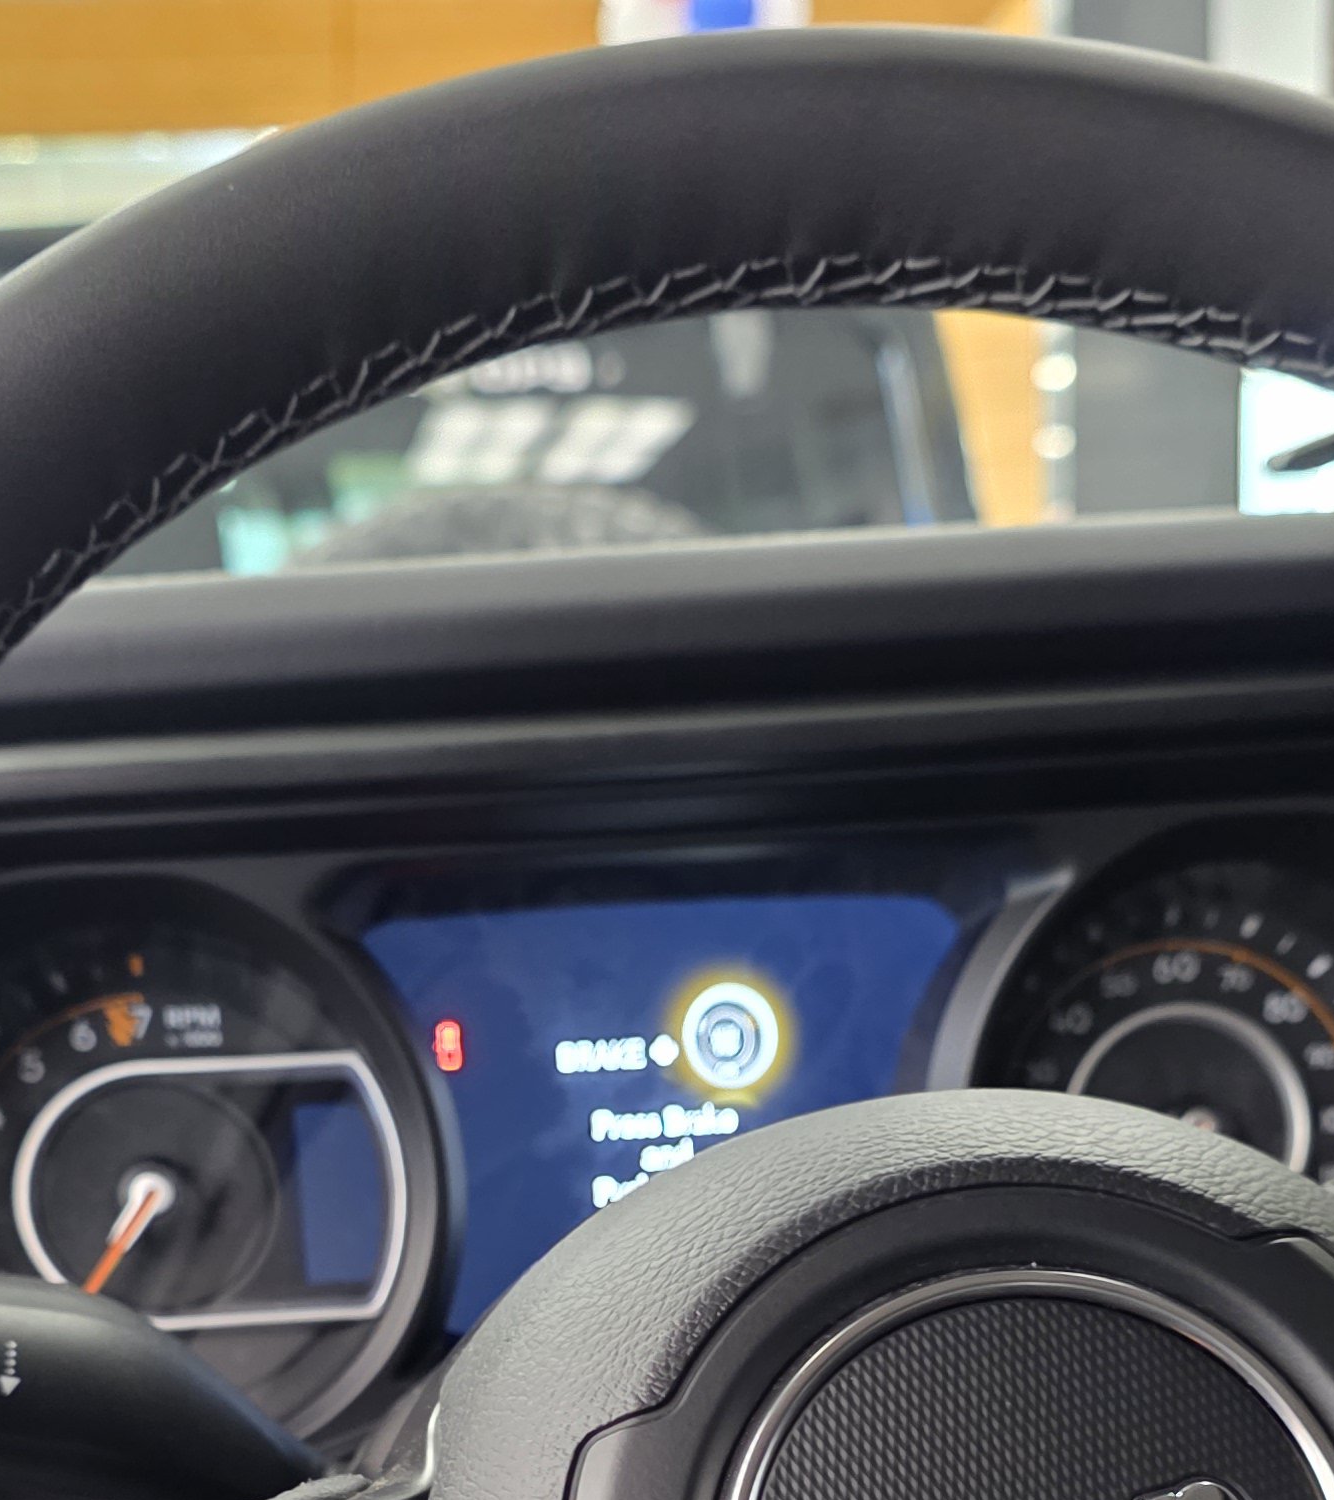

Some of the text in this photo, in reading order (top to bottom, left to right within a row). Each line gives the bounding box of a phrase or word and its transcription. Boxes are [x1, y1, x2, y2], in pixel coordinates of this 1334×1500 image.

[163, 1004, 222, 1029] RPM
[69, 1020, 97, 1052] 6
[18, 1047, 45, 1083] 5
[555, 1036, 647, 1074] BRAKE
[661, 1101, 739, 1138] Brake
